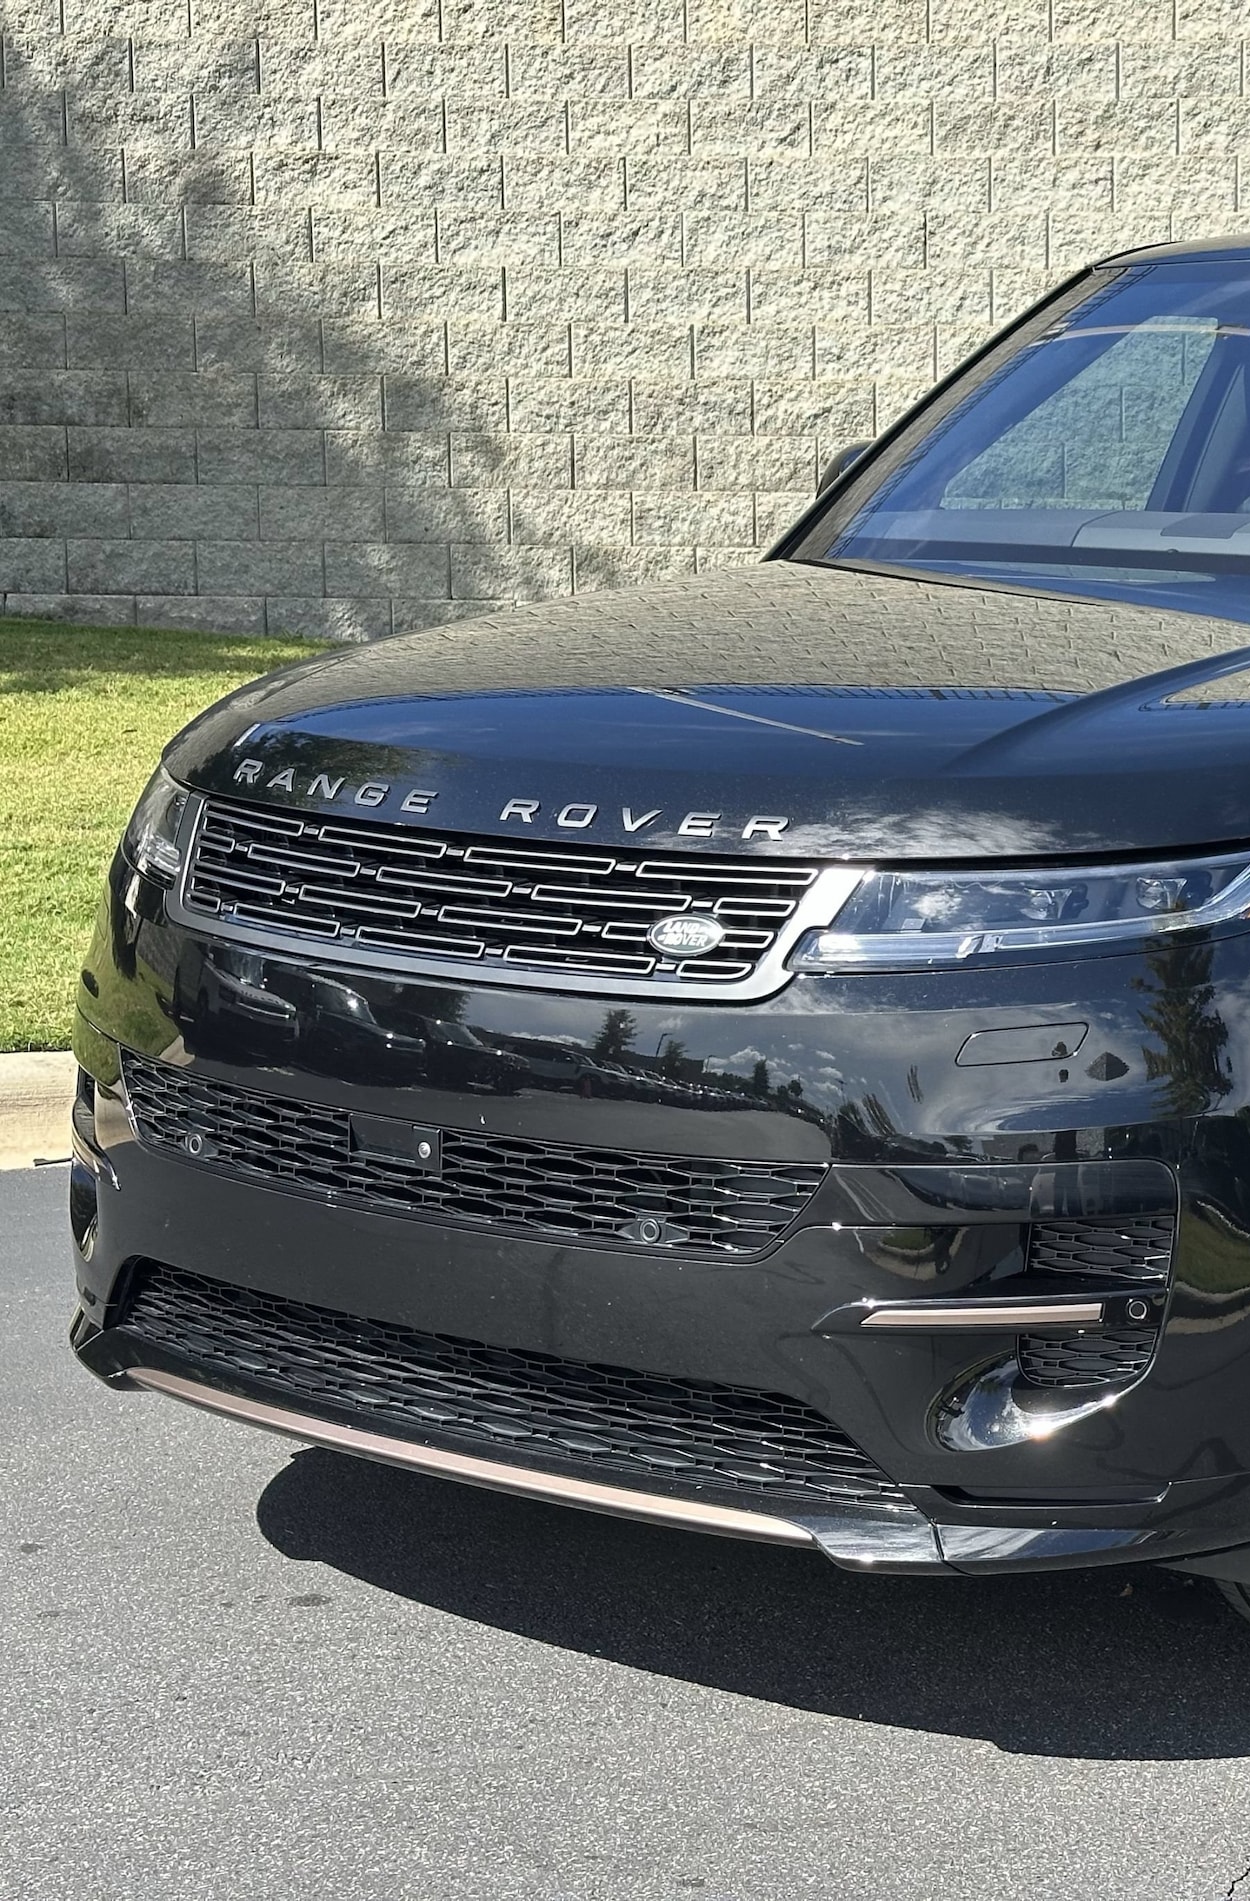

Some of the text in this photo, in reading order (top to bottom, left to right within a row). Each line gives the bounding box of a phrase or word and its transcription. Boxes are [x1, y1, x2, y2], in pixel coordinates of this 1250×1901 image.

[234, 758, 790, 841] RANGE ROVER
[662, 920, 708, 946] LAND ROVER
